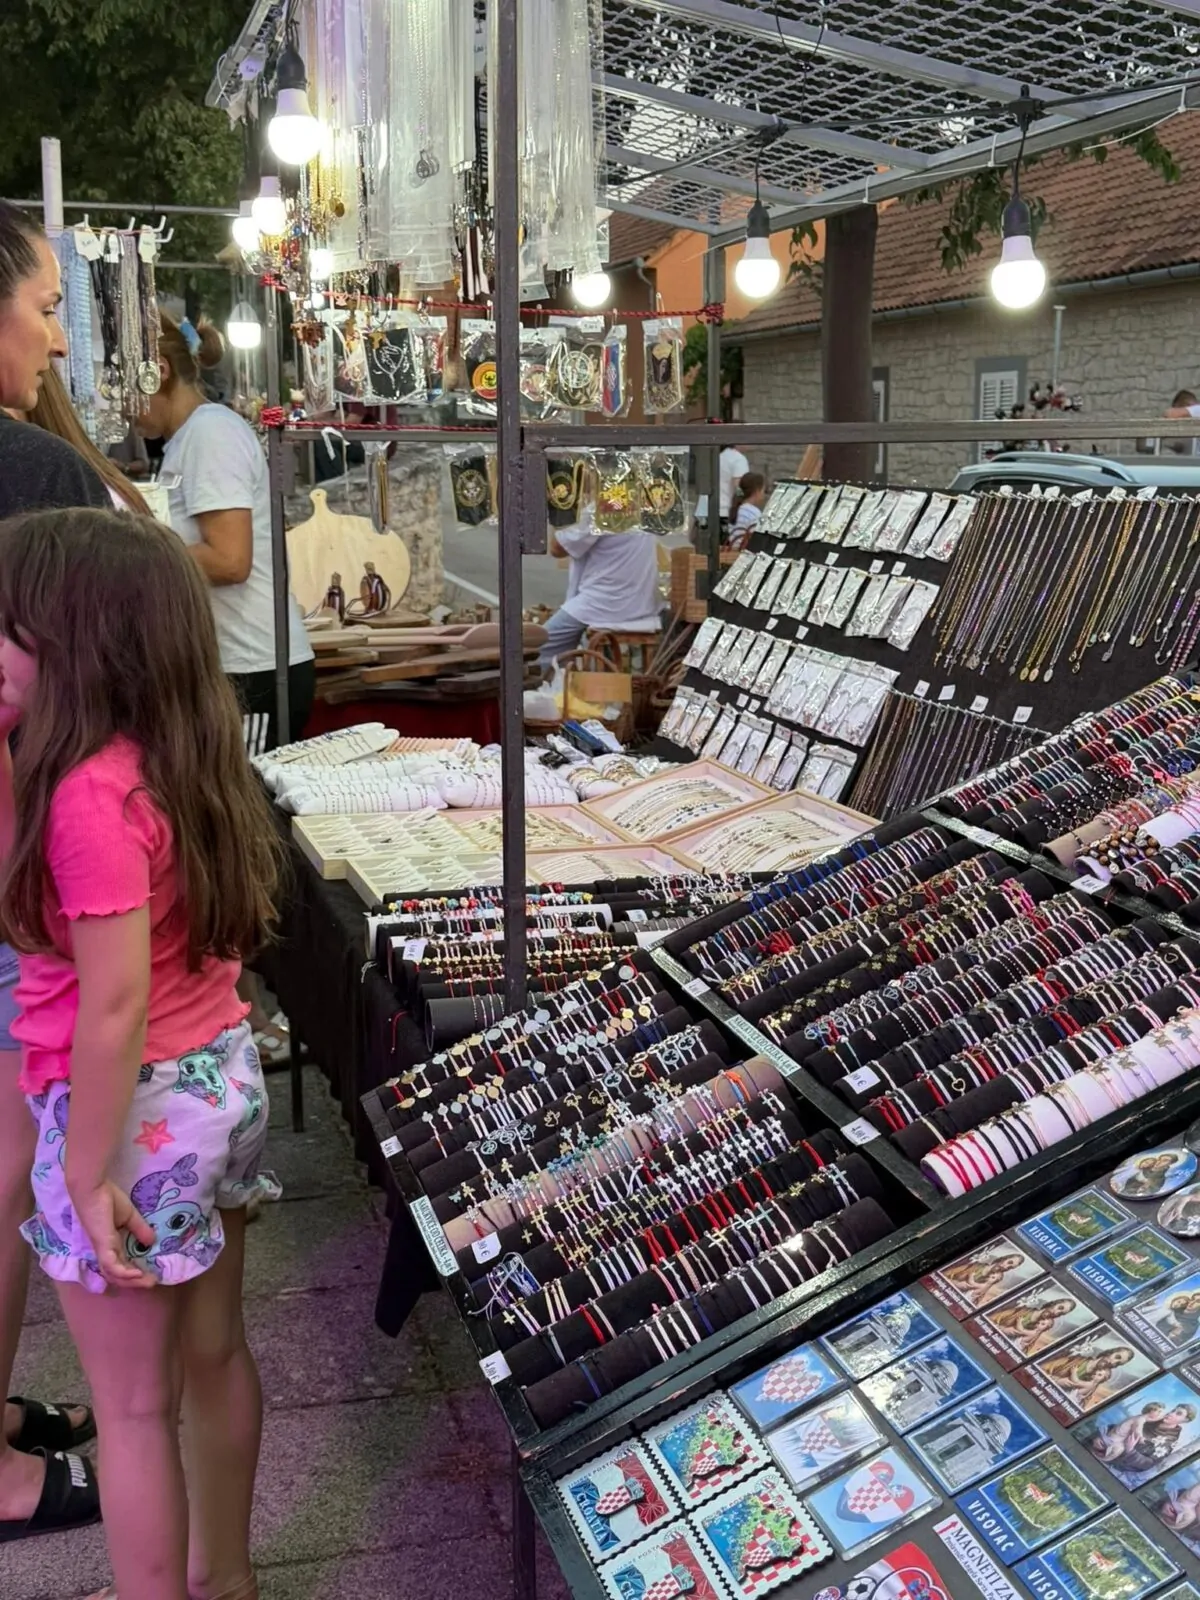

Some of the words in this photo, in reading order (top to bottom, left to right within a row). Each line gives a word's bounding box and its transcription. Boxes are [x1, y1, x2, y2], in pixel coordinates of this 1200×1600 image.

[1028, 1225, 1062, 1253] VISOVAC
[1081, 1264, 1121, 1296] VISOVAC
[577, 1492, 605, 1541] CROATIA
[967, 1499, 1015, 1552] VISOVAC
[951, 1527, 1004, 1587] MAGNETI
[1028, 1568, 1064, 1600] VISO
